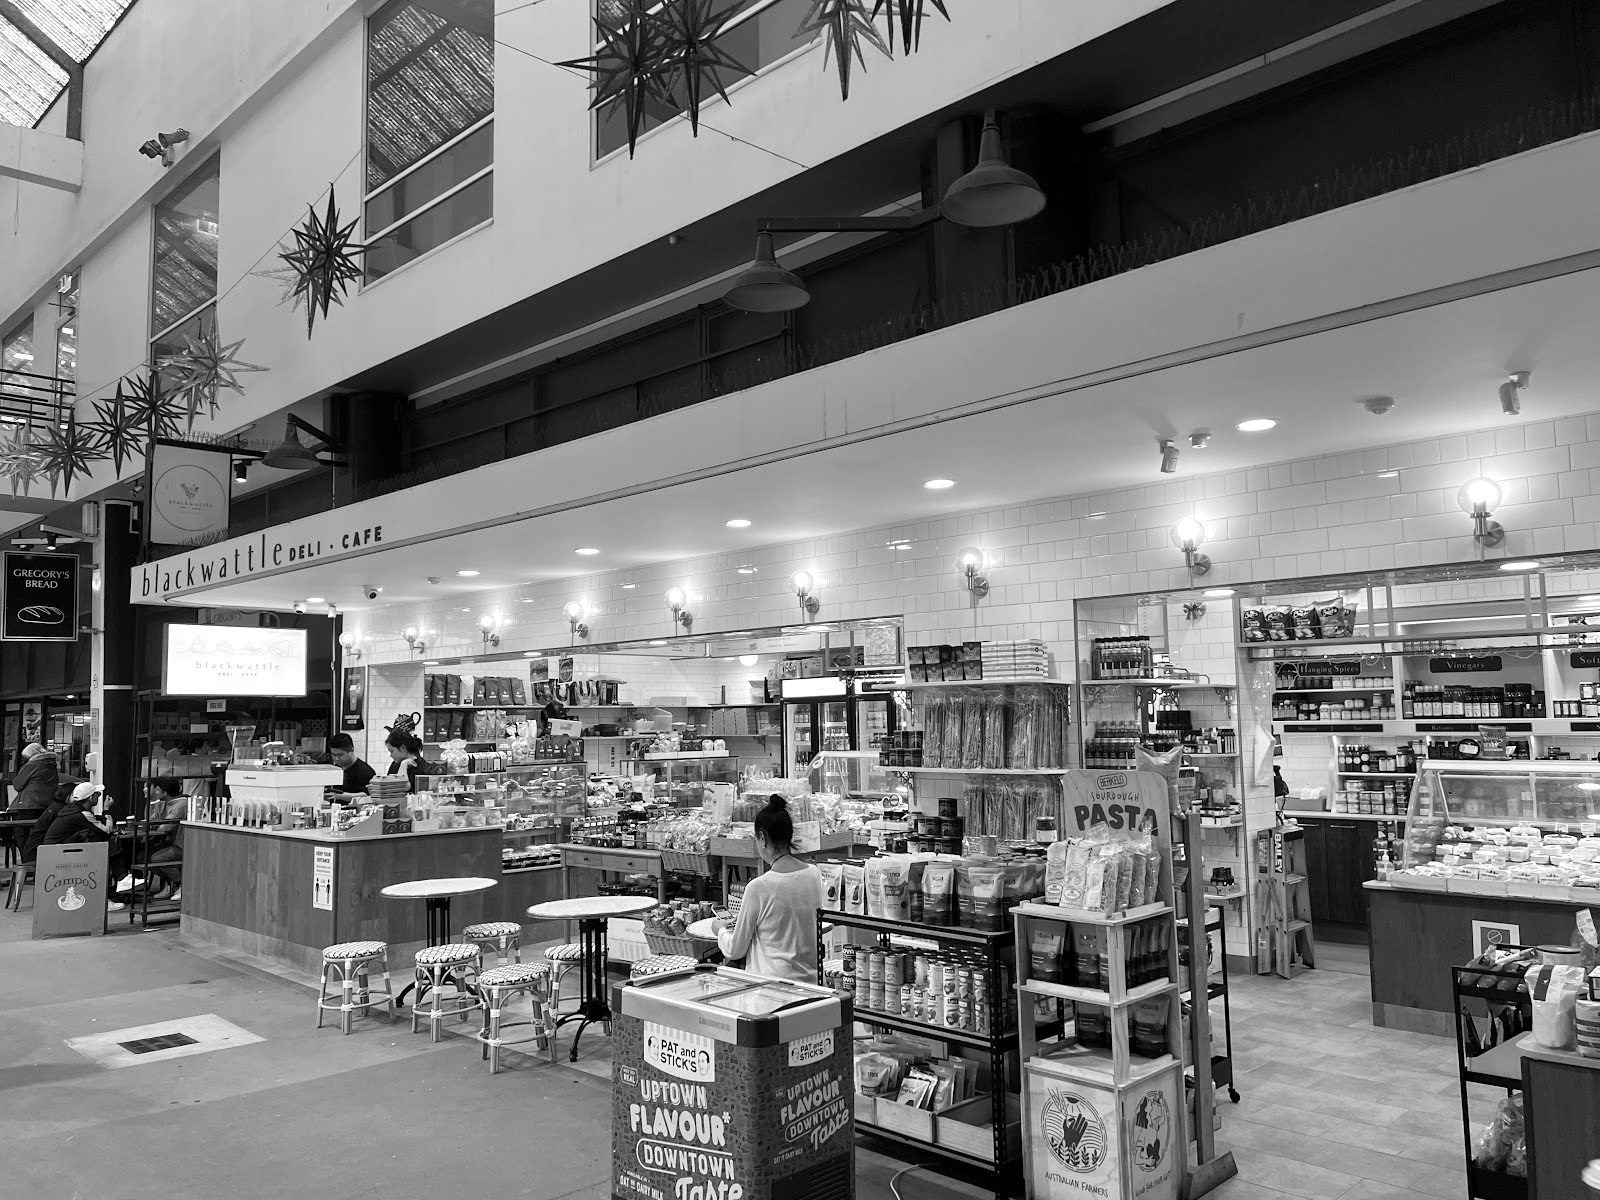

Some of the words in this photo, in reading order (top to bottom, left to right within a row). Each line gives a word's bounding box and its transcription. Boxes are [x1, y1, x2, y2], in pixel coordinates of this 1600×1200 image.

[142, 534, 283, 597] blackwattle
[289, 541, 321, 562] DELI
[341, 525, 382, 549] CAFE
[13, 568, 70, 579] GREGORY'S
[25, 579, 58, 588] BREAD
[195, 660, 281, 671] blackwattle
[1300, 662, 1332, 675] Hanging
[1334, 665, 1360, 676] Spices
[1446, 661, 1485, 670] Vinegars
[1091, 791, 1140, 802] SOURDOUGH
[1074, 803, 1159, 837] PASTA
[661, 1039, 679, 1054] PAT
[680, 1045, 696, 1058] and
[799, 1047, 824, 1061] STICK'S
[800, 1043, 813, 1053] PAT
[812, 1040, 823, 1050] and
[660, 1052, 698, 1073] STICK'S
[623, 1073, 636, 1084] REAL
[787, 1068, 830, 1100] UPTOWN
[640, 1078, 708, 1110] UPTOWN
[789, 1098, 845, 1138] DOWNTOWN
[810, 1108, 850, 1151] Taste
[643, 1143, 735, 1181] DOWNTOWN
[619, 1174, 630, 1188] OAT
[636, 1181, 651, 1197] DAIRY
[651, 1187, 664, 1200] MILK
[675, 1176, 743, 1200] Taste
[1045, 1171, 1080, 1189] AUSTRALIAN
[1080, 1181, 1109, 1198] FARMERS
